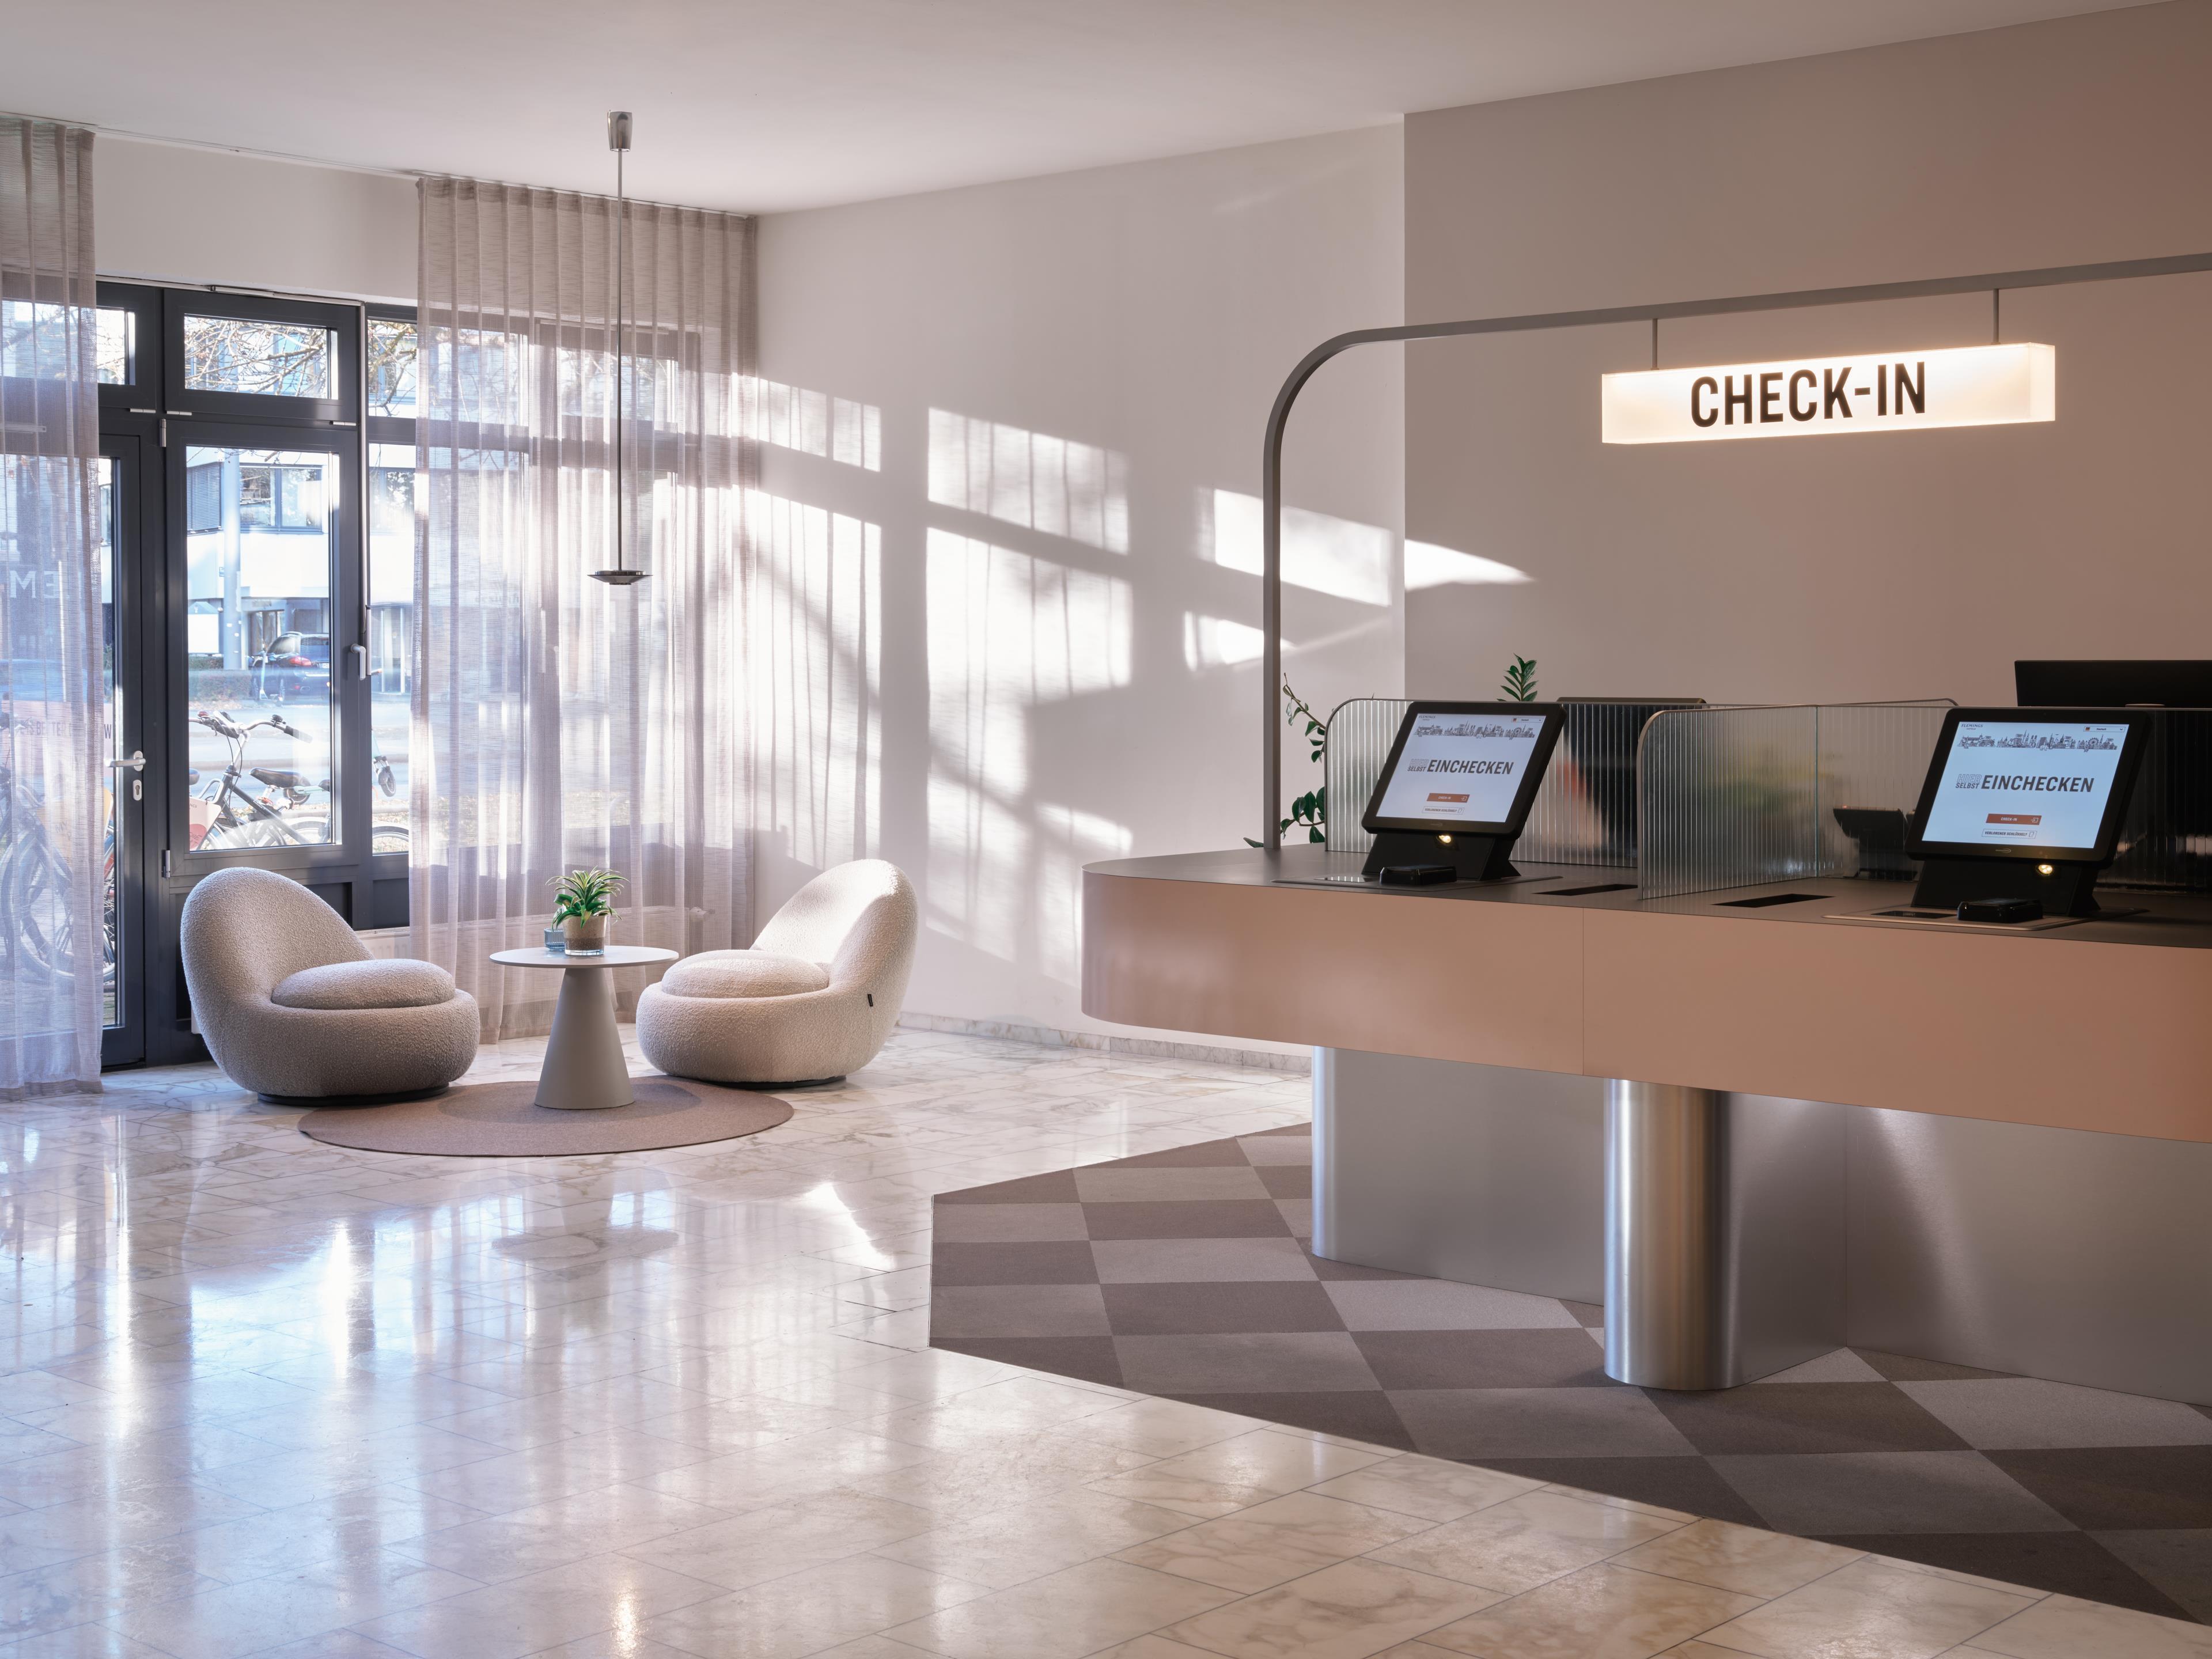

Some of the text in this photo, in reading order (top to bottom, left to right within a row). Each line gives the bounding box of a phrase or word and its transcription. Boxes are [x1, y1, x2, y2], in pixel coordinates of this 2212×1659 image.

[1690, 361, 1926, 428] CHECK-IN
[1427, 759, 1514, 775] EINCHECKEN
[1957, 774, 1982, 784] HIER
[1981, 775, 2095, 793] EINCHECKEN
